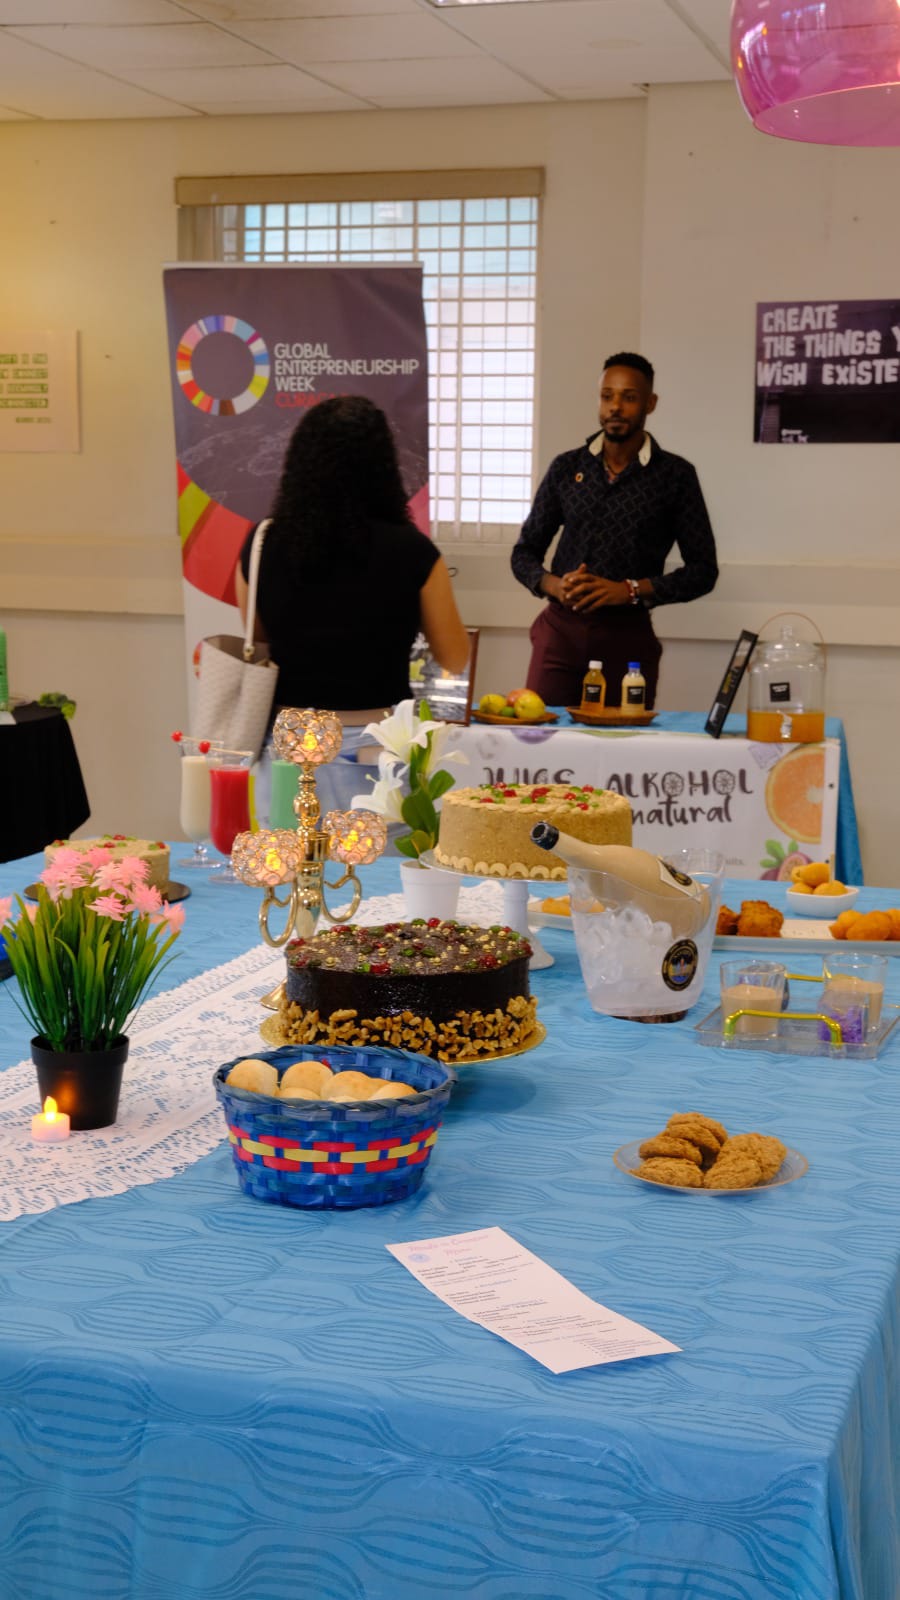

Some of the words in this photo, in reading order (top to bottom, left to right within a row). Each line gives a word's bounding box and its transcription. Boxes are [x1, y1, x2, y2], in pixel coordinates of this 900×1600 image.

[762, 304, 838, 333] CREATE
[274, 343, 331, 359] GLOBAL
[762, 335, 796, 360] THE
[274, 359, 419, 376] ENTREPRENEURSHIP
[275, 376, 315, 392] WEEK
[605, 768, 754, 798] ALKOHOL
[631, 794, 732, 827] natural
